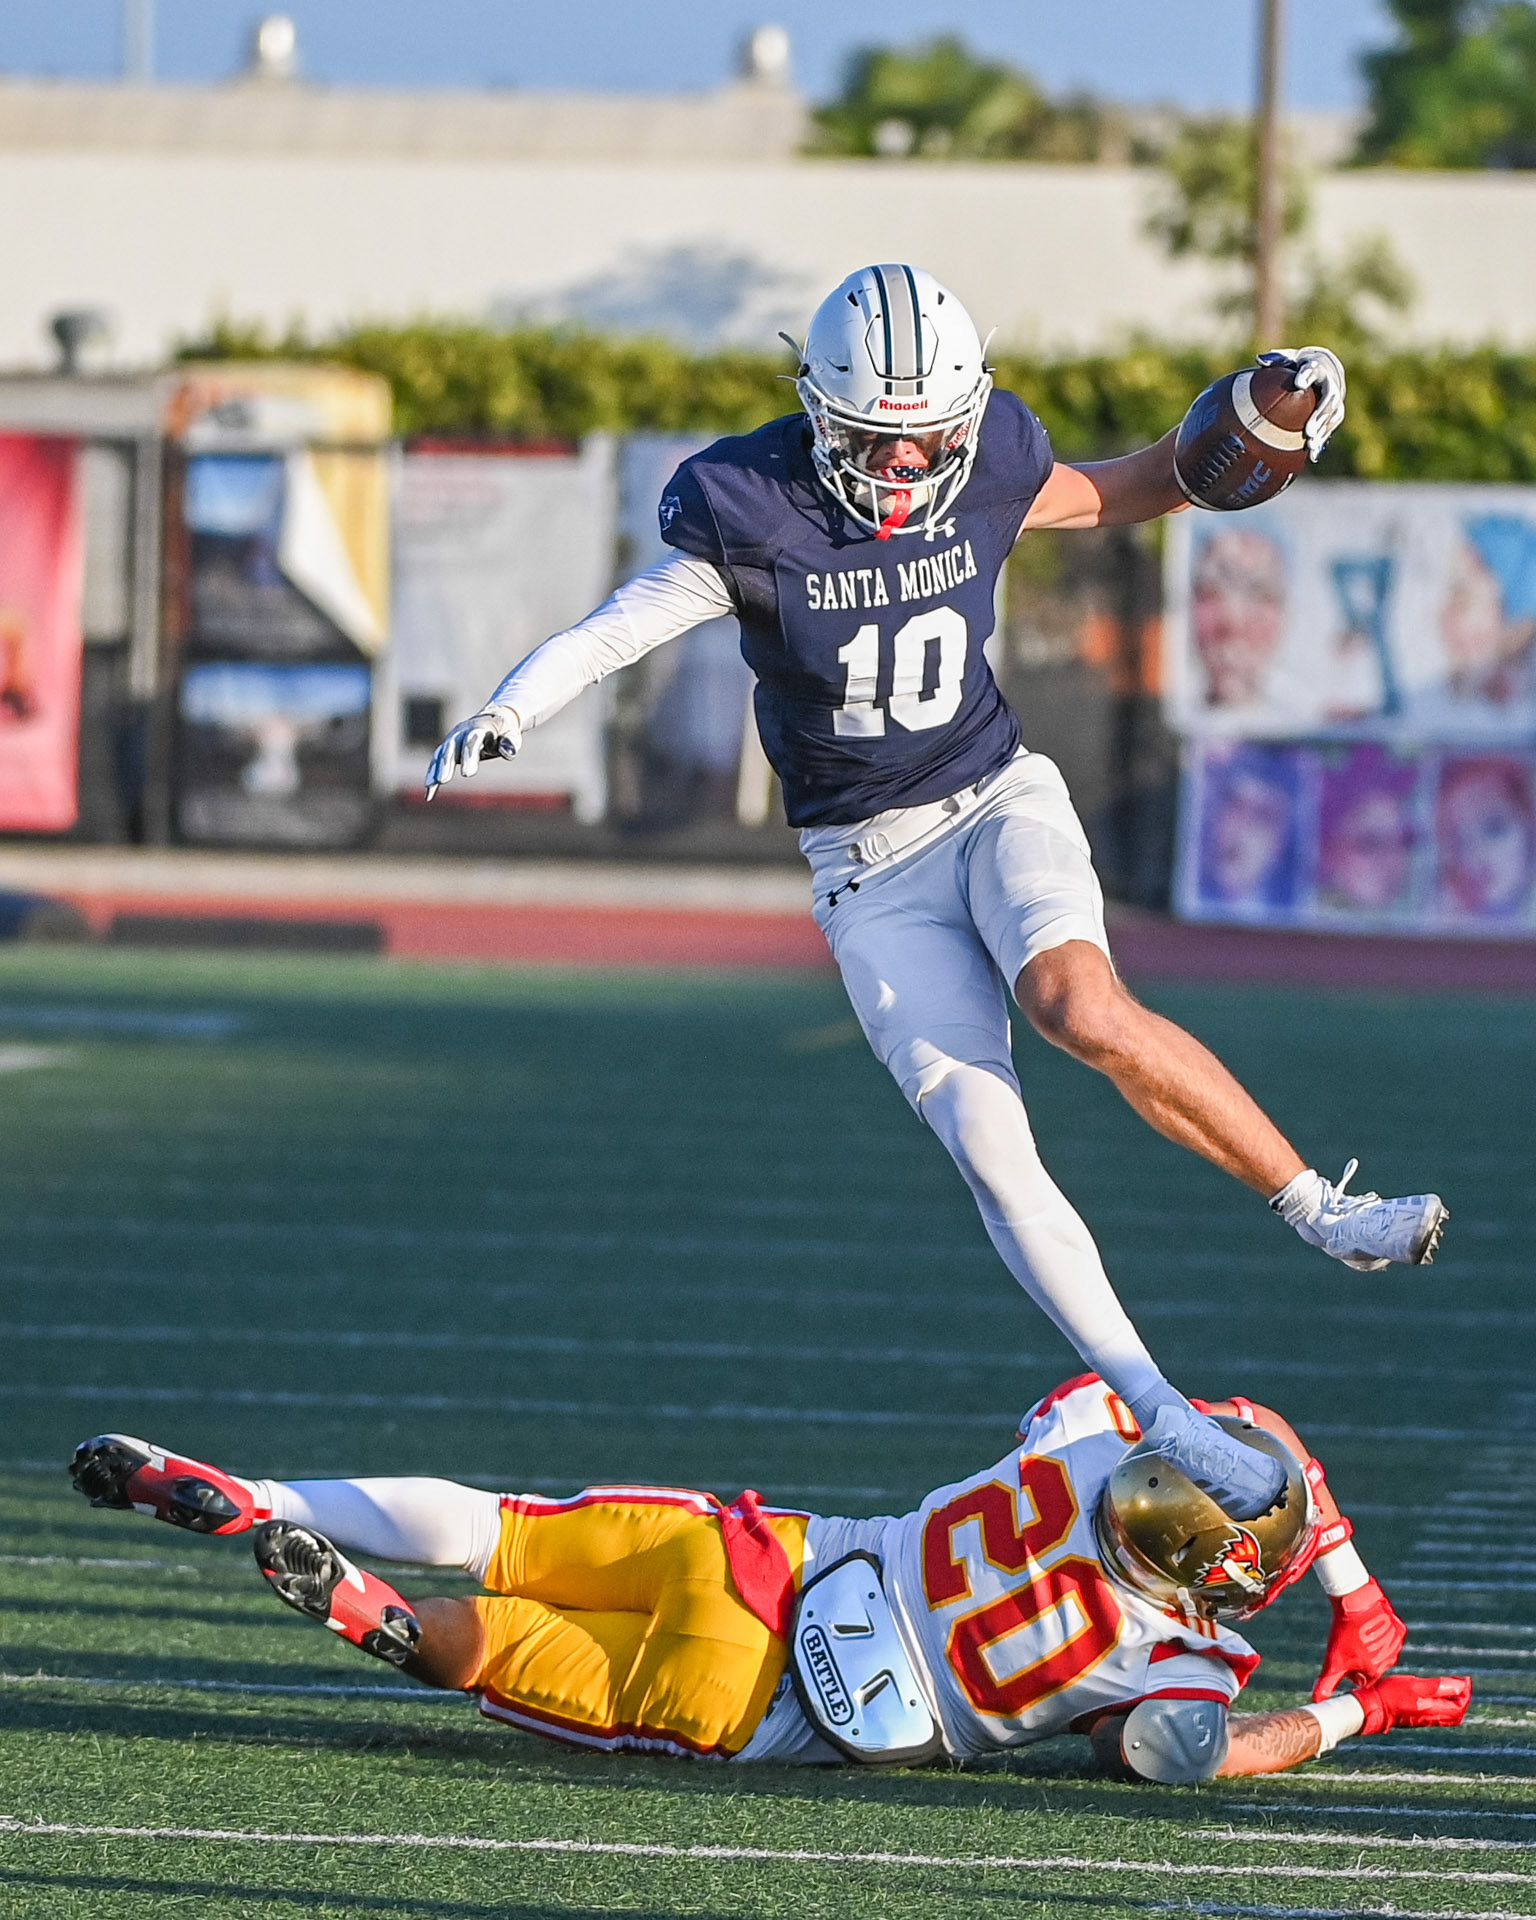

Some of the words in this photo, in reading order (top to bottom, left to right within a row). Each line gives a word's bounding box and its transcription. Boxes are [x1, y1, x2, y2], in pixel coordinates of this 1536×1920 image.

[879, 399, 928, 411] Riddell
[947, 423, 971, 450] Ridd
[806, 567, 890, 611] SANTA
[896, 539, 978, 602] MONICA
[832, 605, 968, 736] 10
[921, 1452, 1126, 1719] 20
[805, 1632, 848, 1718] BATTLE
